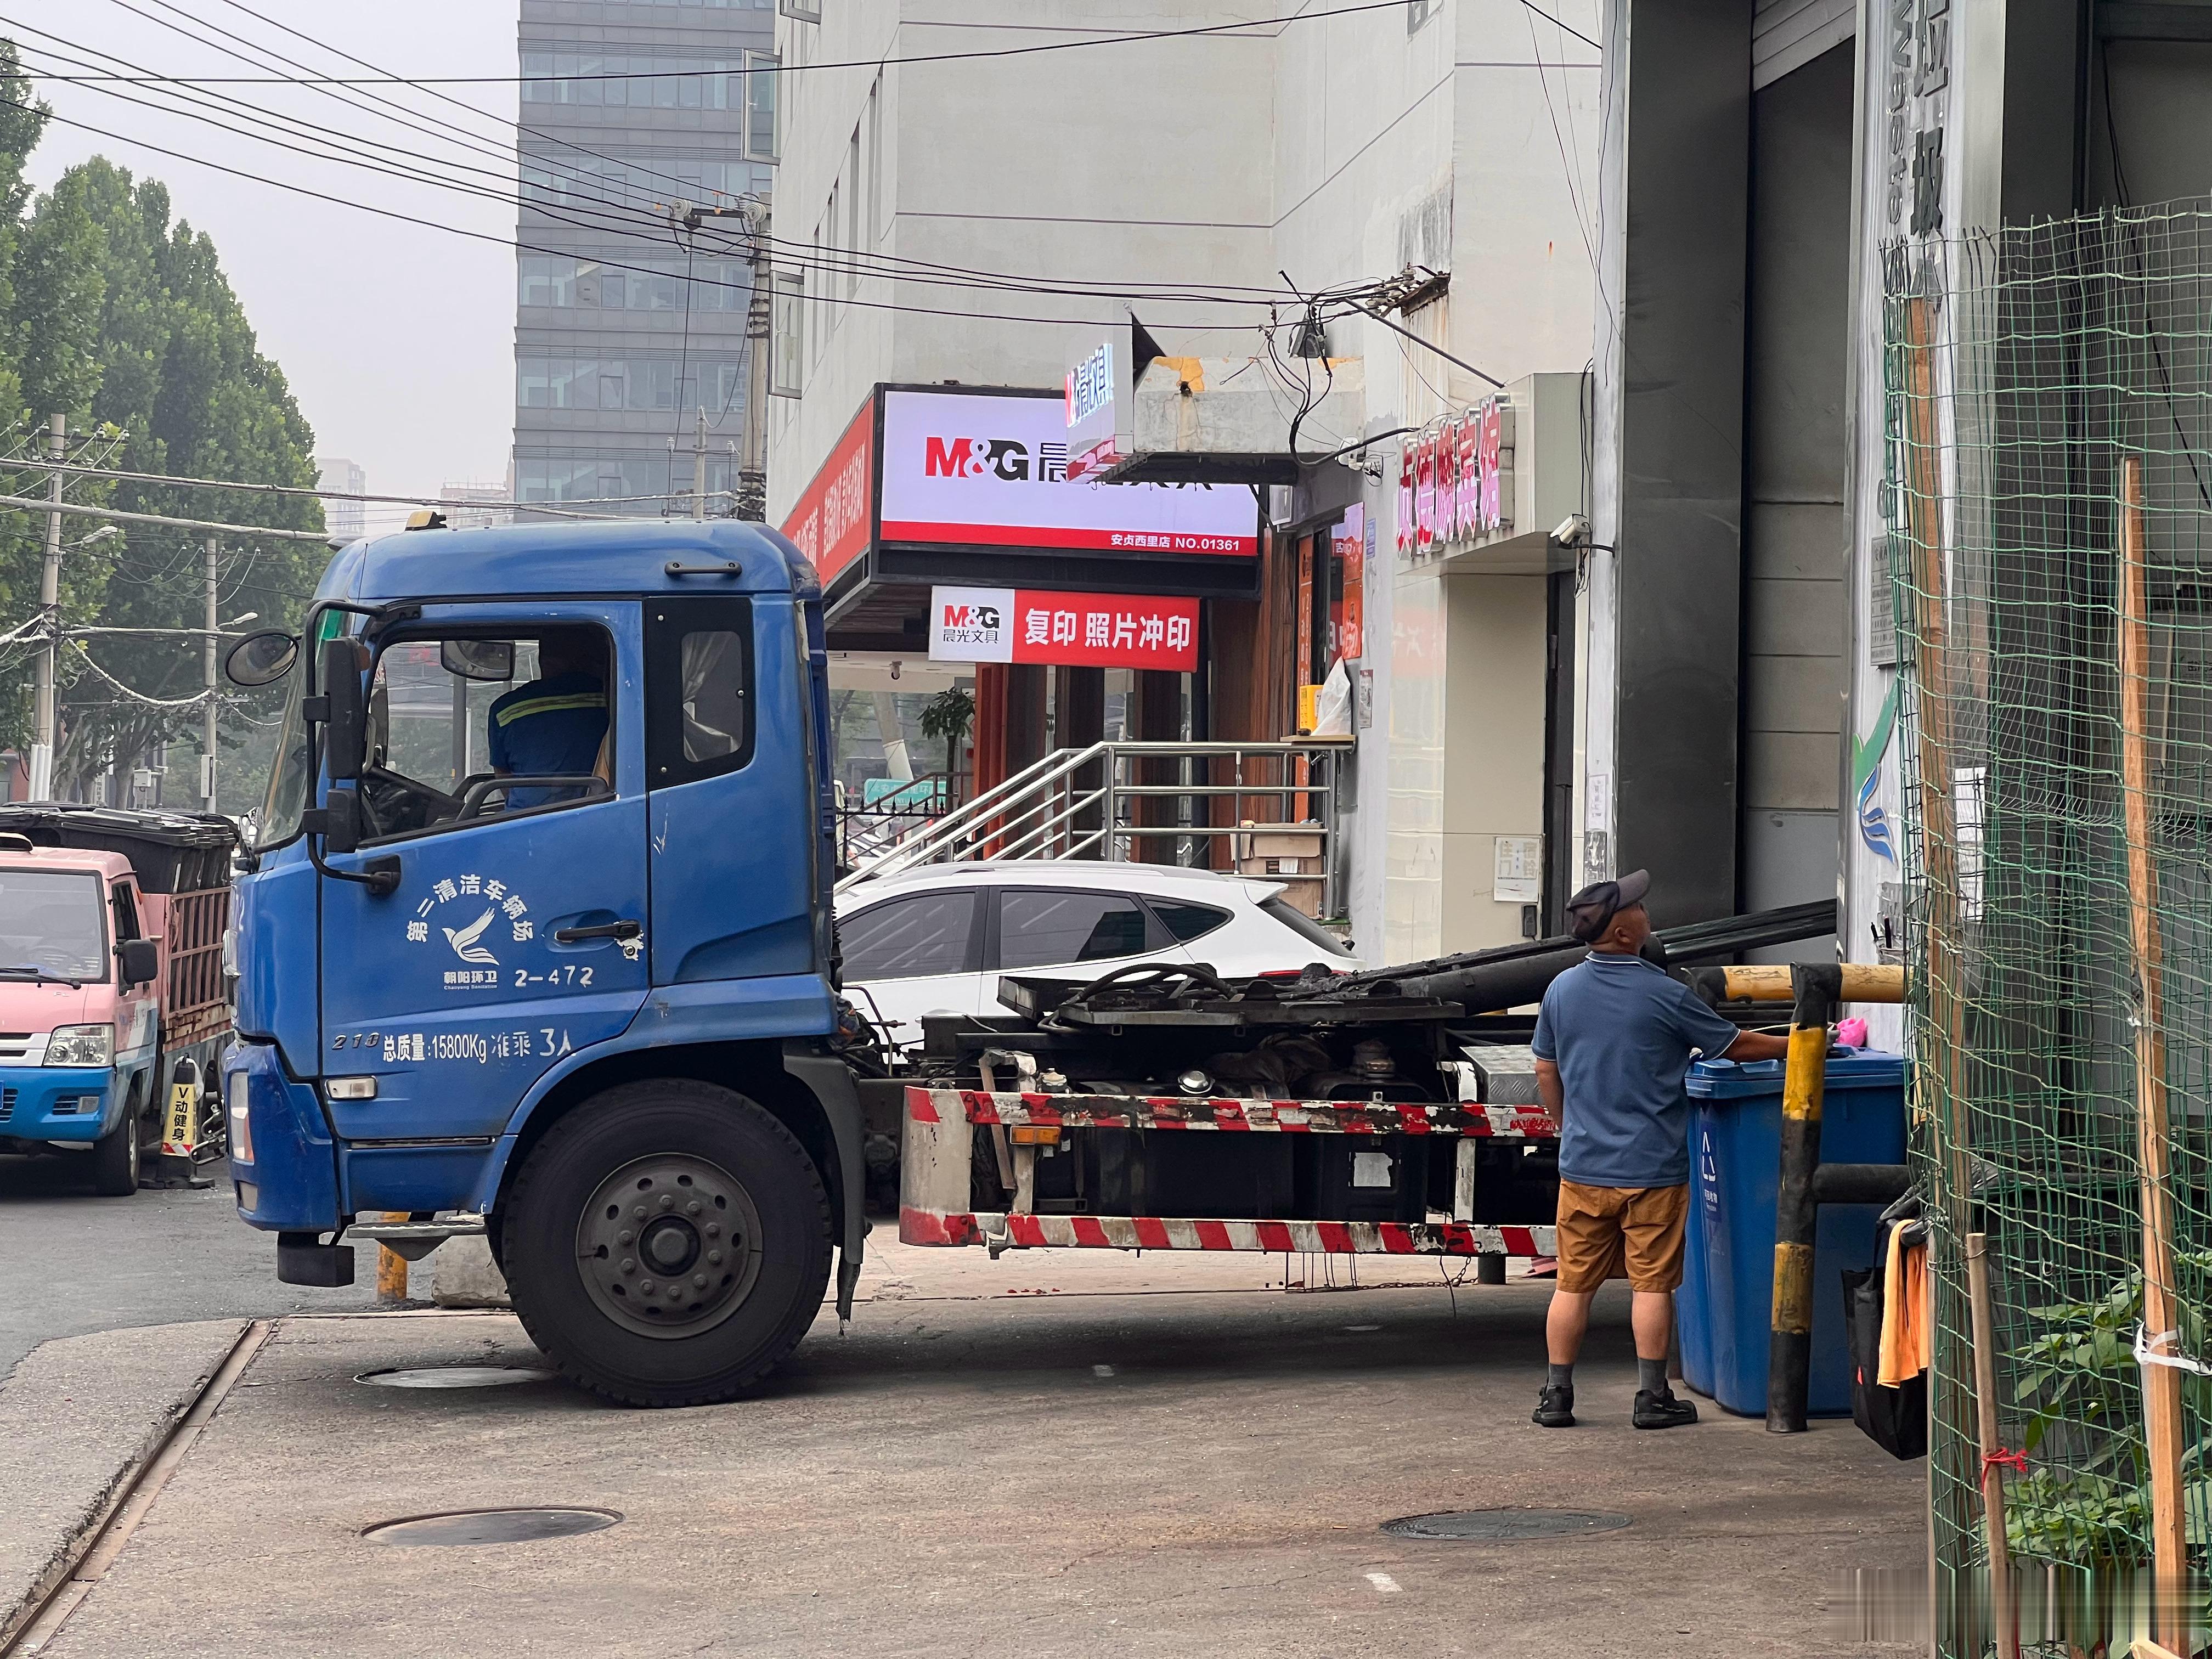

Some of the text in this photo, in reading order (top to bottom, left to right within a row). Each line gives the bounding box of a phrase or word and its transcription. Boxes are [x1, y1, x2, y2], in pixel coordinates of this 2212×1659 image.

[925, 437, 1029, 481] M&G
[1111, 534, 1240, 551] 安贞西里店 NO.01361
[944, 605, 1000, 629] M&G
[943, 629, 998, 644] 晨光文具
[1025, 608, 1191, 652] 复印 照片冲印
[407, 874, 533, 943] 第二清洁车辆场
[444, 970, 497, 984] 朝阳环卫
[515, 965, 594, 988] 2-472
[331, 1032, 380, 1050] 210
